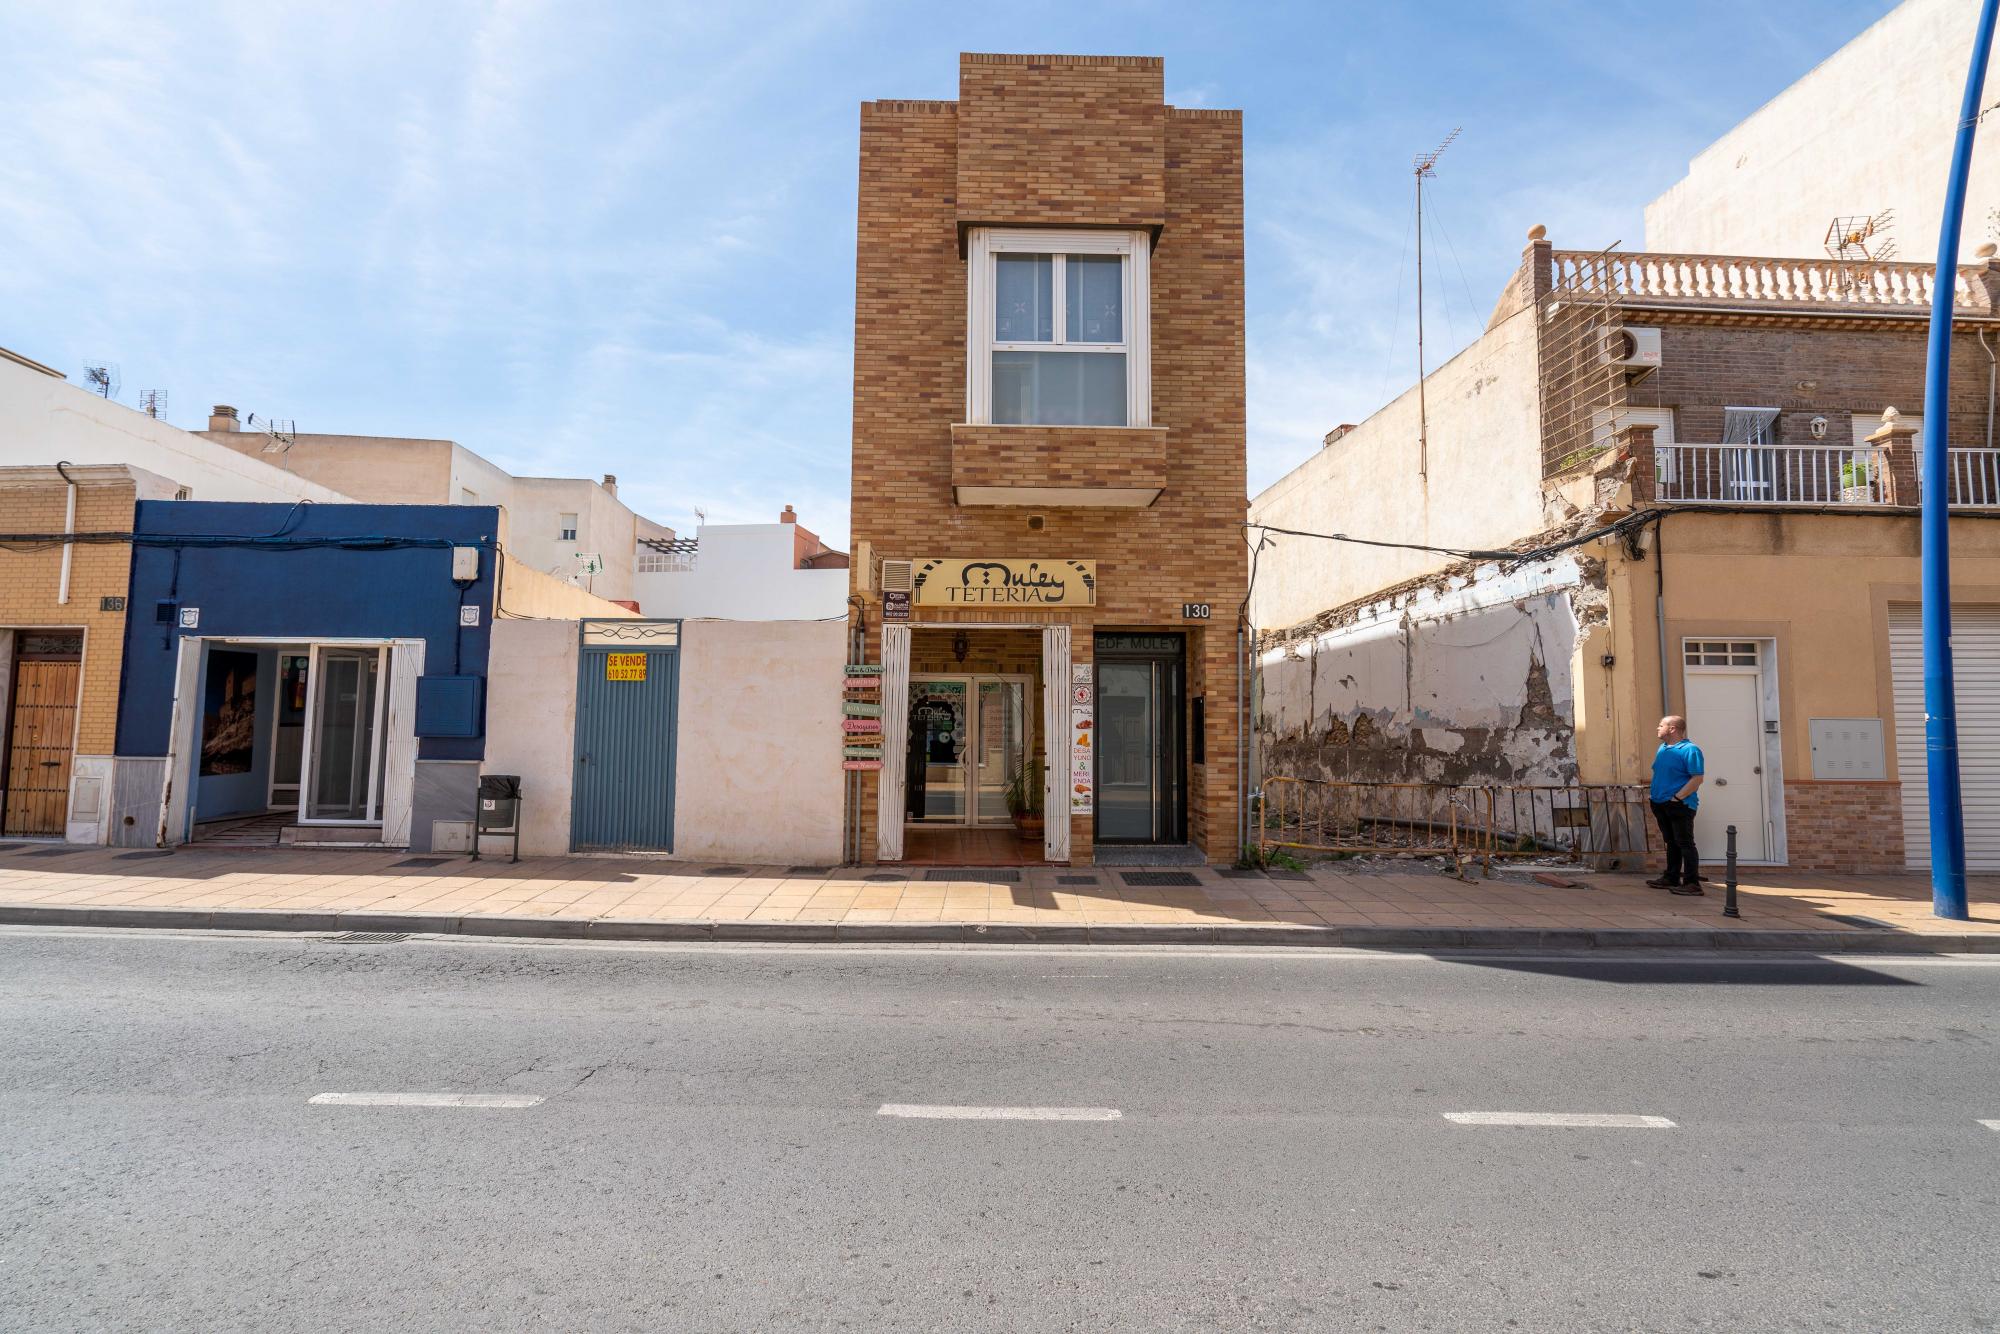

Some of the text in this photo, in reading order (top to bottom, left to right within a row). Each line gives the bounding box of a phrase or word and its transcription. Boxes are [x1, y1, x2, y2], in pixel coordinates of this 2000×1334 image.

[962, 562, 1064, 602] Muley
[946, 586, 1044, 602] TETERIA
[101, 597, 123, 610] 136
[1185, 604, 1209, 618] 130
[1096, 637, 1178, 649] EDF. MULEY
[608, 655, 647, 666] SE VENDE
[608, 669, 619, 679] 610
[620, 669, 629, 679] 52
[630, 669, 638, 679] 77
[1079, 761, 1086, 770] &
